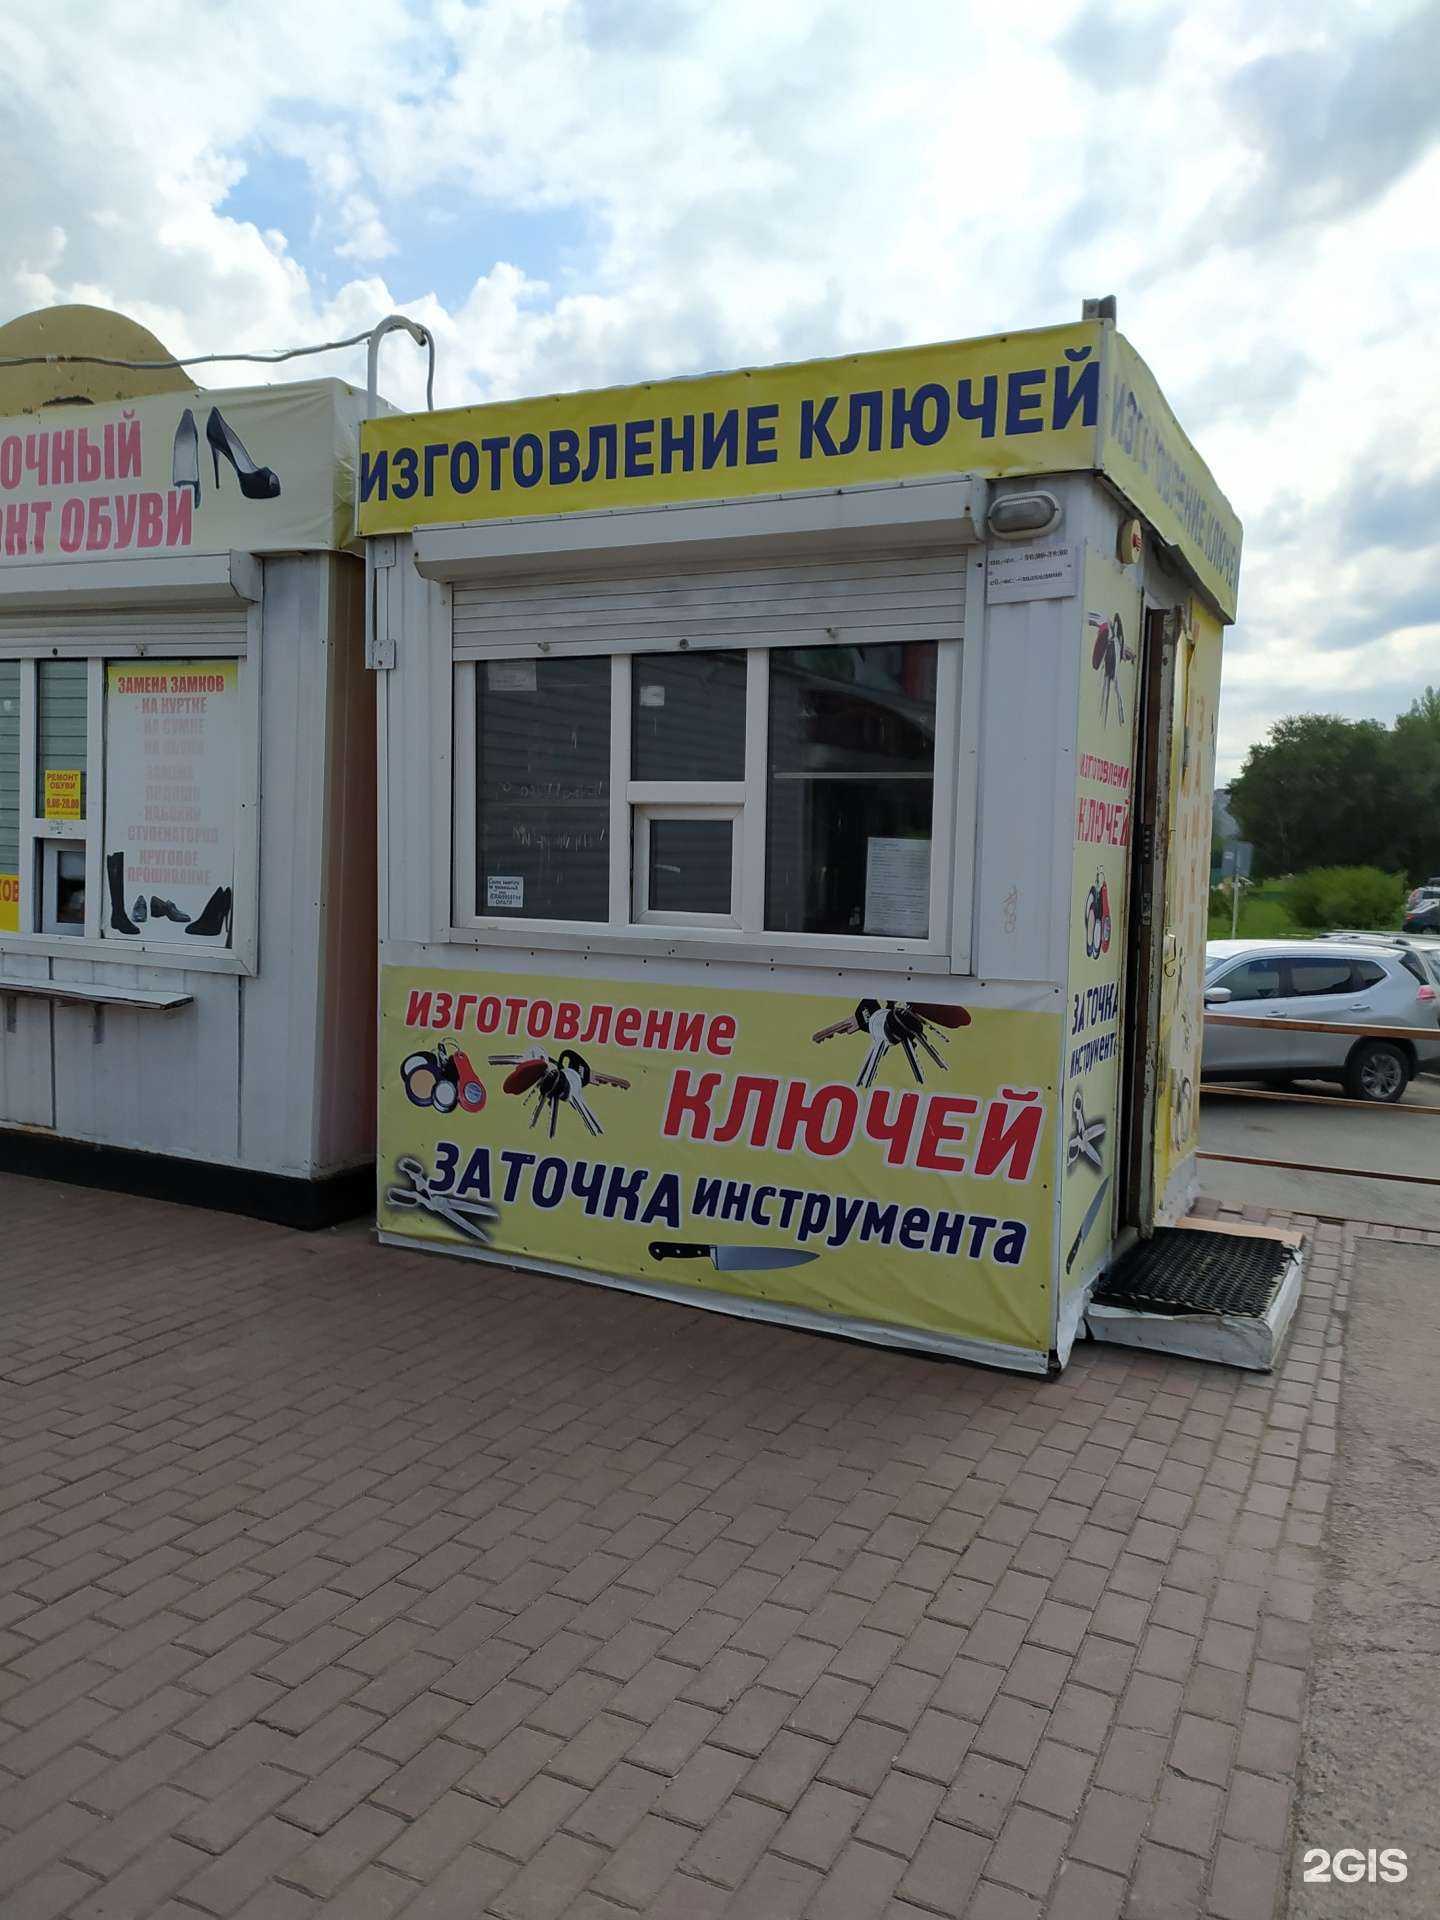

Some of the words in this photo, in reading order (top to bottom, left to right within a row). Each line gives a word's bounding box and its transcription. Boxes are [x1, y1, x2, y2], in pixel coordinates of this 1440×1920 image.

[0, 409, 142, 490] ОЧНЫЙ
[360, 403, 779, 502] ИЗГОТОВЛЕНИЕ
[800, 346, 1099, 460] КЛЮЧЕЙ
[0, 501, 52, 556] НТ
[60, 489, 192, 553] ОБУВИ
[118, 676, 167, 694] ЗАМЕНА
[171, 675, 224, 693] ЗАМКОВ
[0, 880, 19, 902] ОВ
[1072, 980, 1118, 1036] ЗАТОЧКА
[663, 1069, 1043, 1181] КЛЮЧЕЙ
[428, 1142, 680, 1229] ЗАТОЧКА
[692, 1177, 1028, 1265] инструмента
